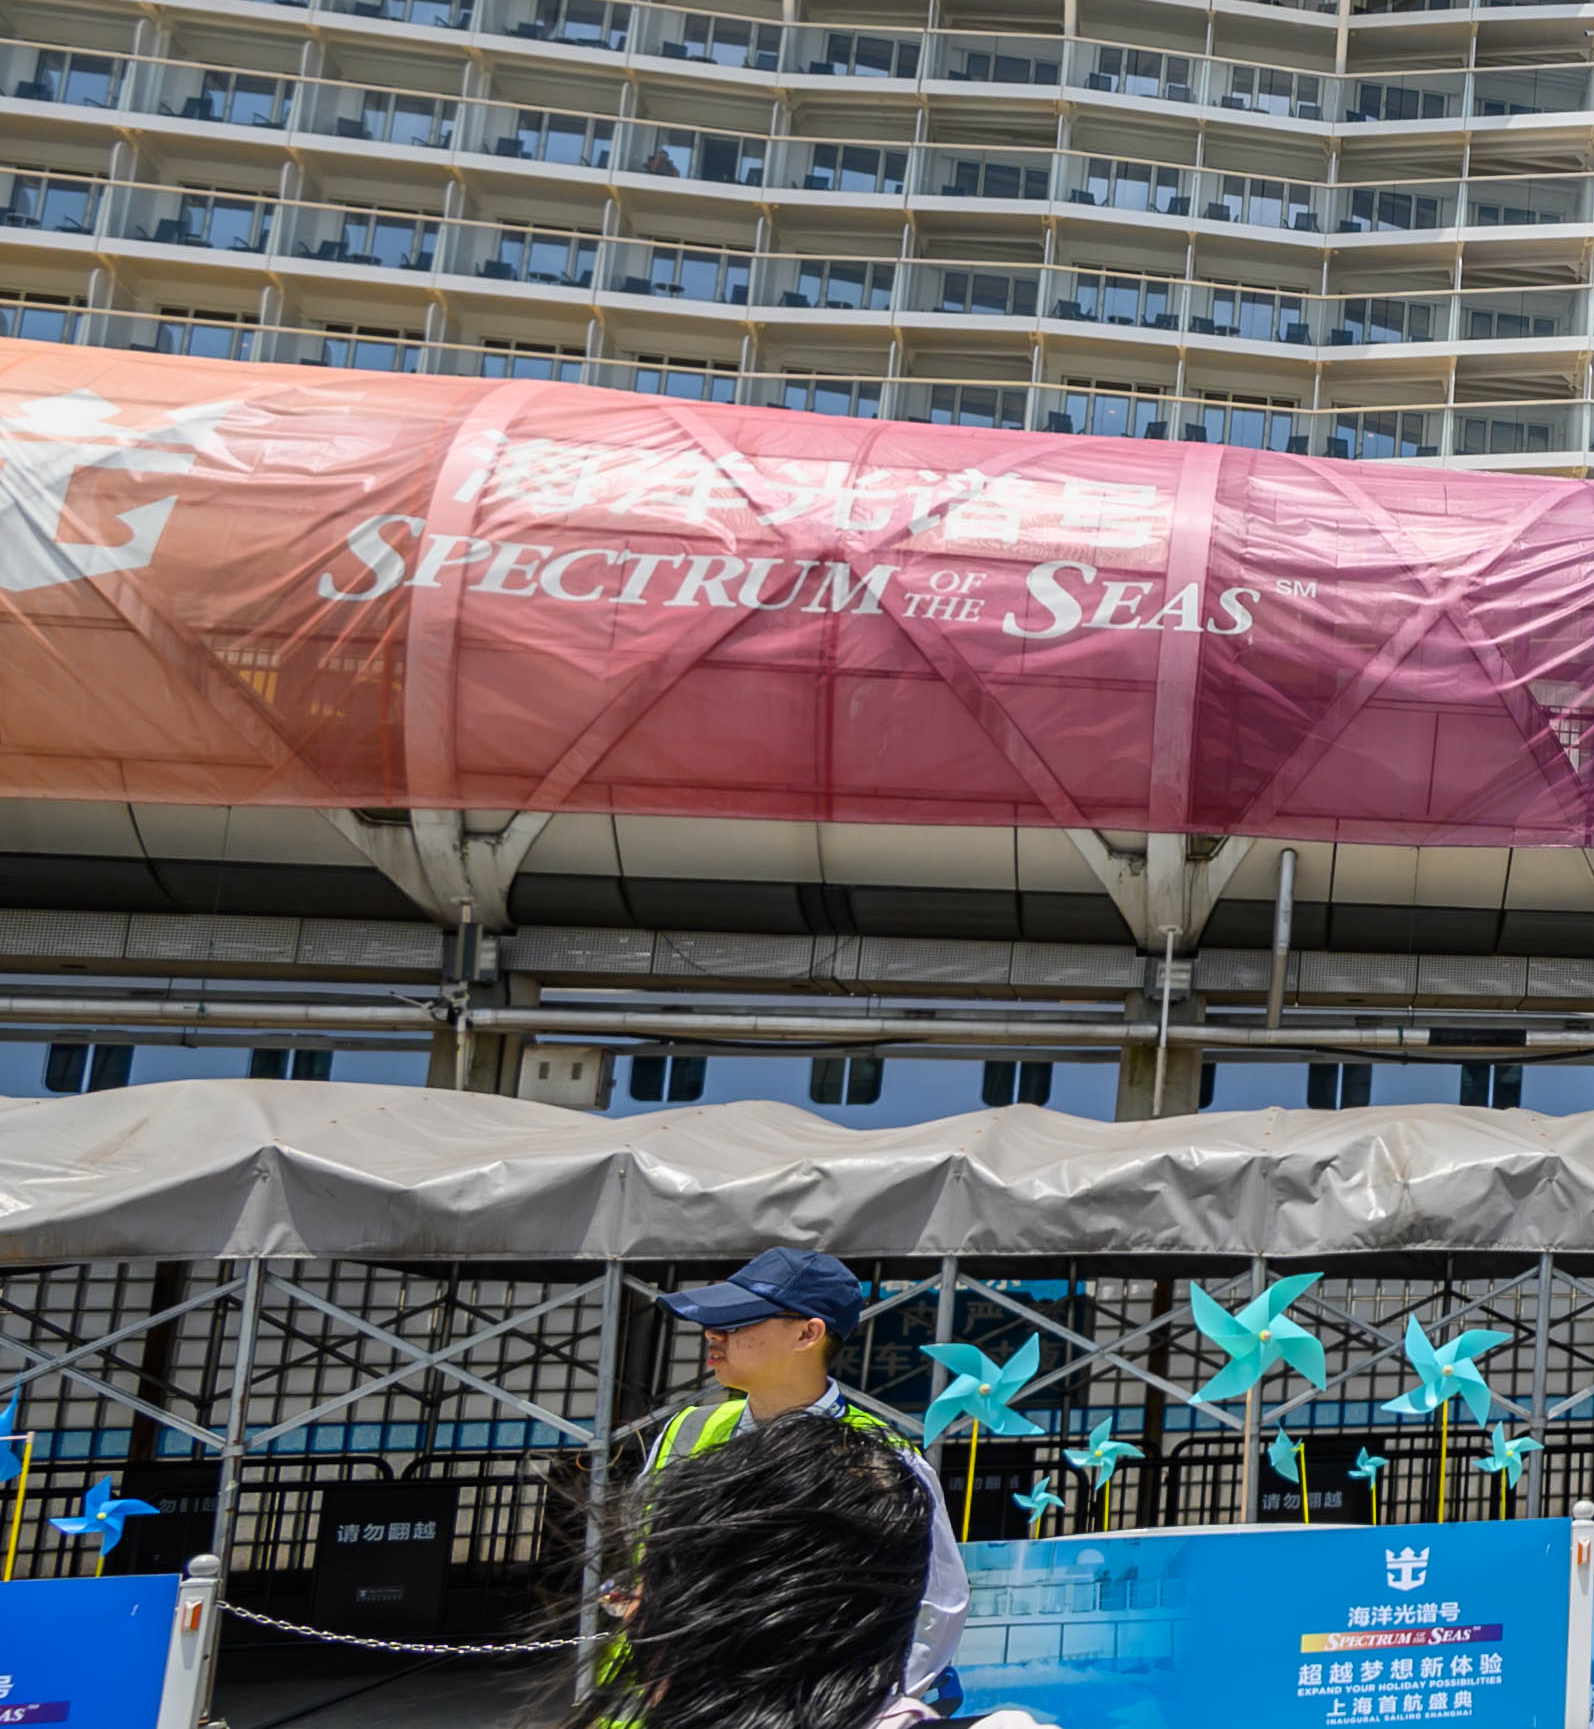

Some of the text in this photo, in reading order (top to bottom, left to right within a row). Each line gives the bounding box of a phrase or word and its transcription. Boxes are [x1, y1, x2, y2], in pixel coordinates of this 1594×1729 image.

[454, 428, 1158, 549] 海洋光谱号
[317, 514, 901, 615] SPECTRUM
[929, 570, 986, 594] OF
[901, 592, 985, 623] THE
[1001, 559, 1262, 640] SEAS
[1348, 1602, 1460, 1627] 海洋光谱号
[1325, 1632, 1412, 1651] SPECTRUM
[1428, 1627, 1471, 1645] SEAS
[1298, 1652, 1503, 1686] 超越梦想新体验
[1297, 1676, 1502, 1697] EXPAND YOUR HOLIDAY POSSIBILITIES
[1326, 1690, 1473, 1718] 上海首航盛典
